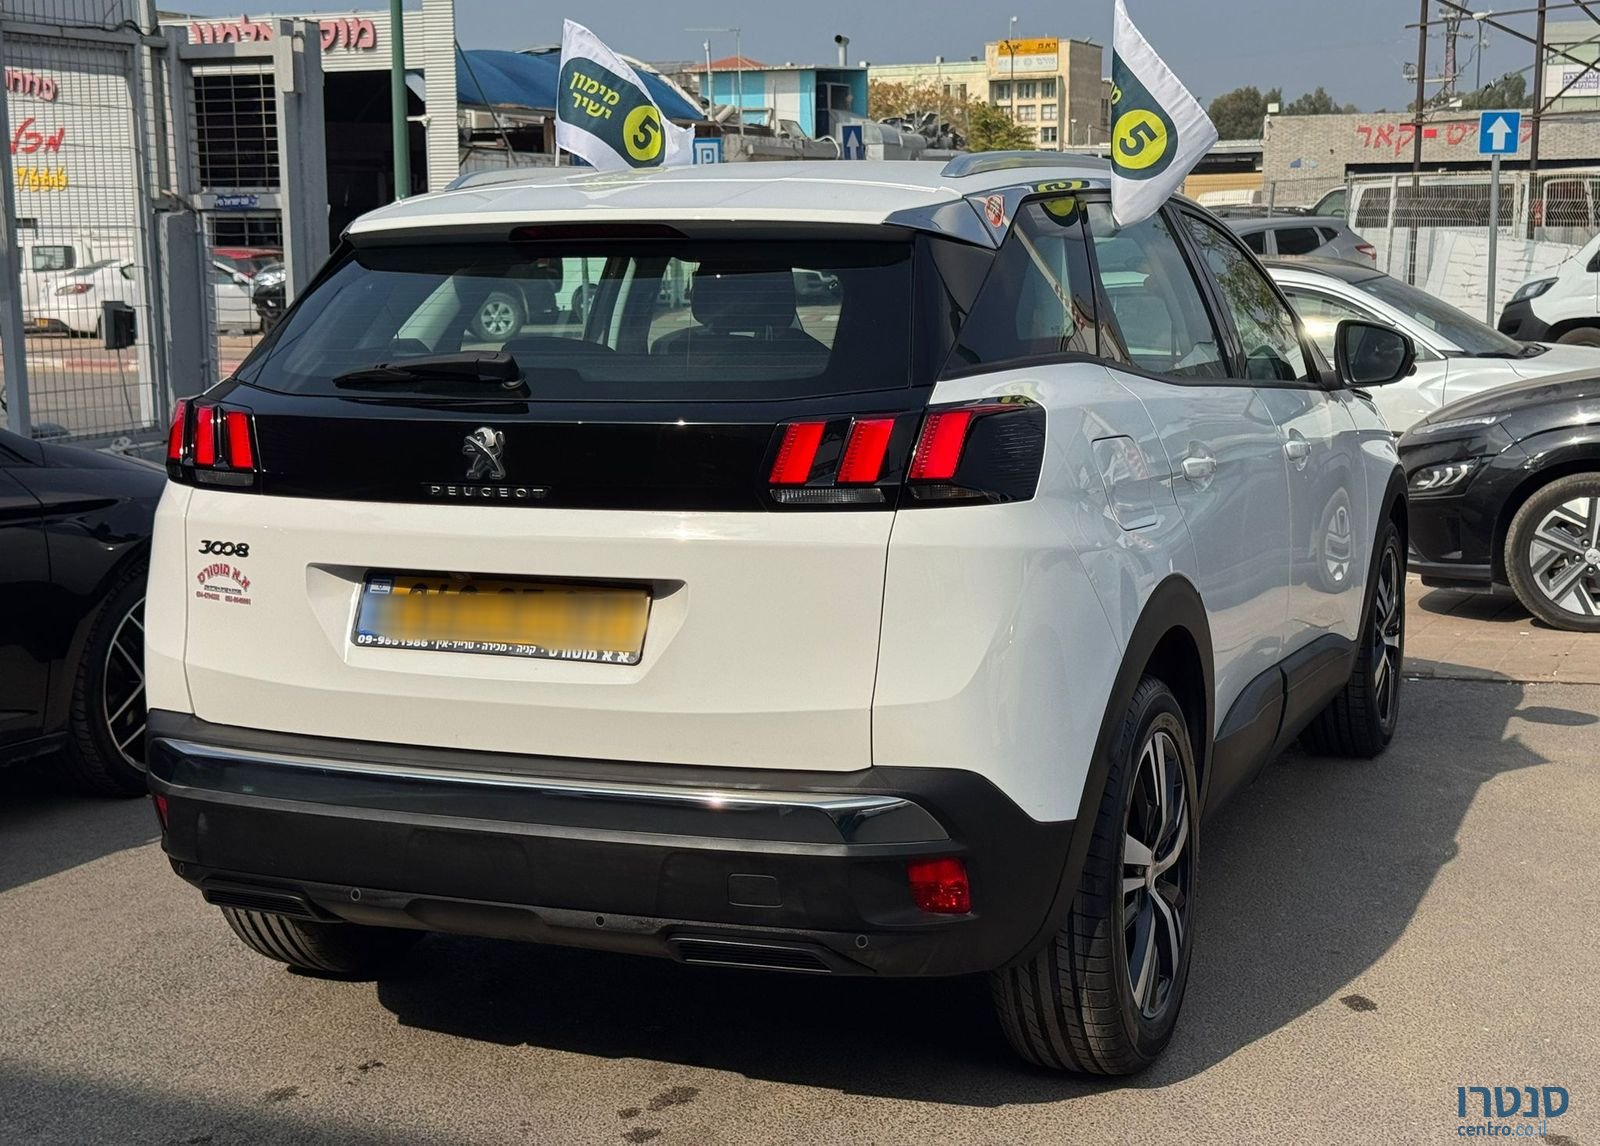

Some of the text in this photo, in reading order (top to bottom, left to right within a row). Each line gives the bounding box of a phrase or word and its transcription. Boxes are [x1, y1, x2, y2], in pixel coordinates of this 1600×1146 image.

[569, 71, 621, 106] מימון
[572, 92, 614, 120] ישיר
[633, 115, 659, 150] 5
[1119, 120, 1158, 156] 5
[431, 485, 545, 498] PEUGEOT
[198, 540, 250, 558] 3008
[197, 563, 231, 585] מוטורס
[481, 642, 507, 652] מכירה
[516, 644, 537, 655] קניה
